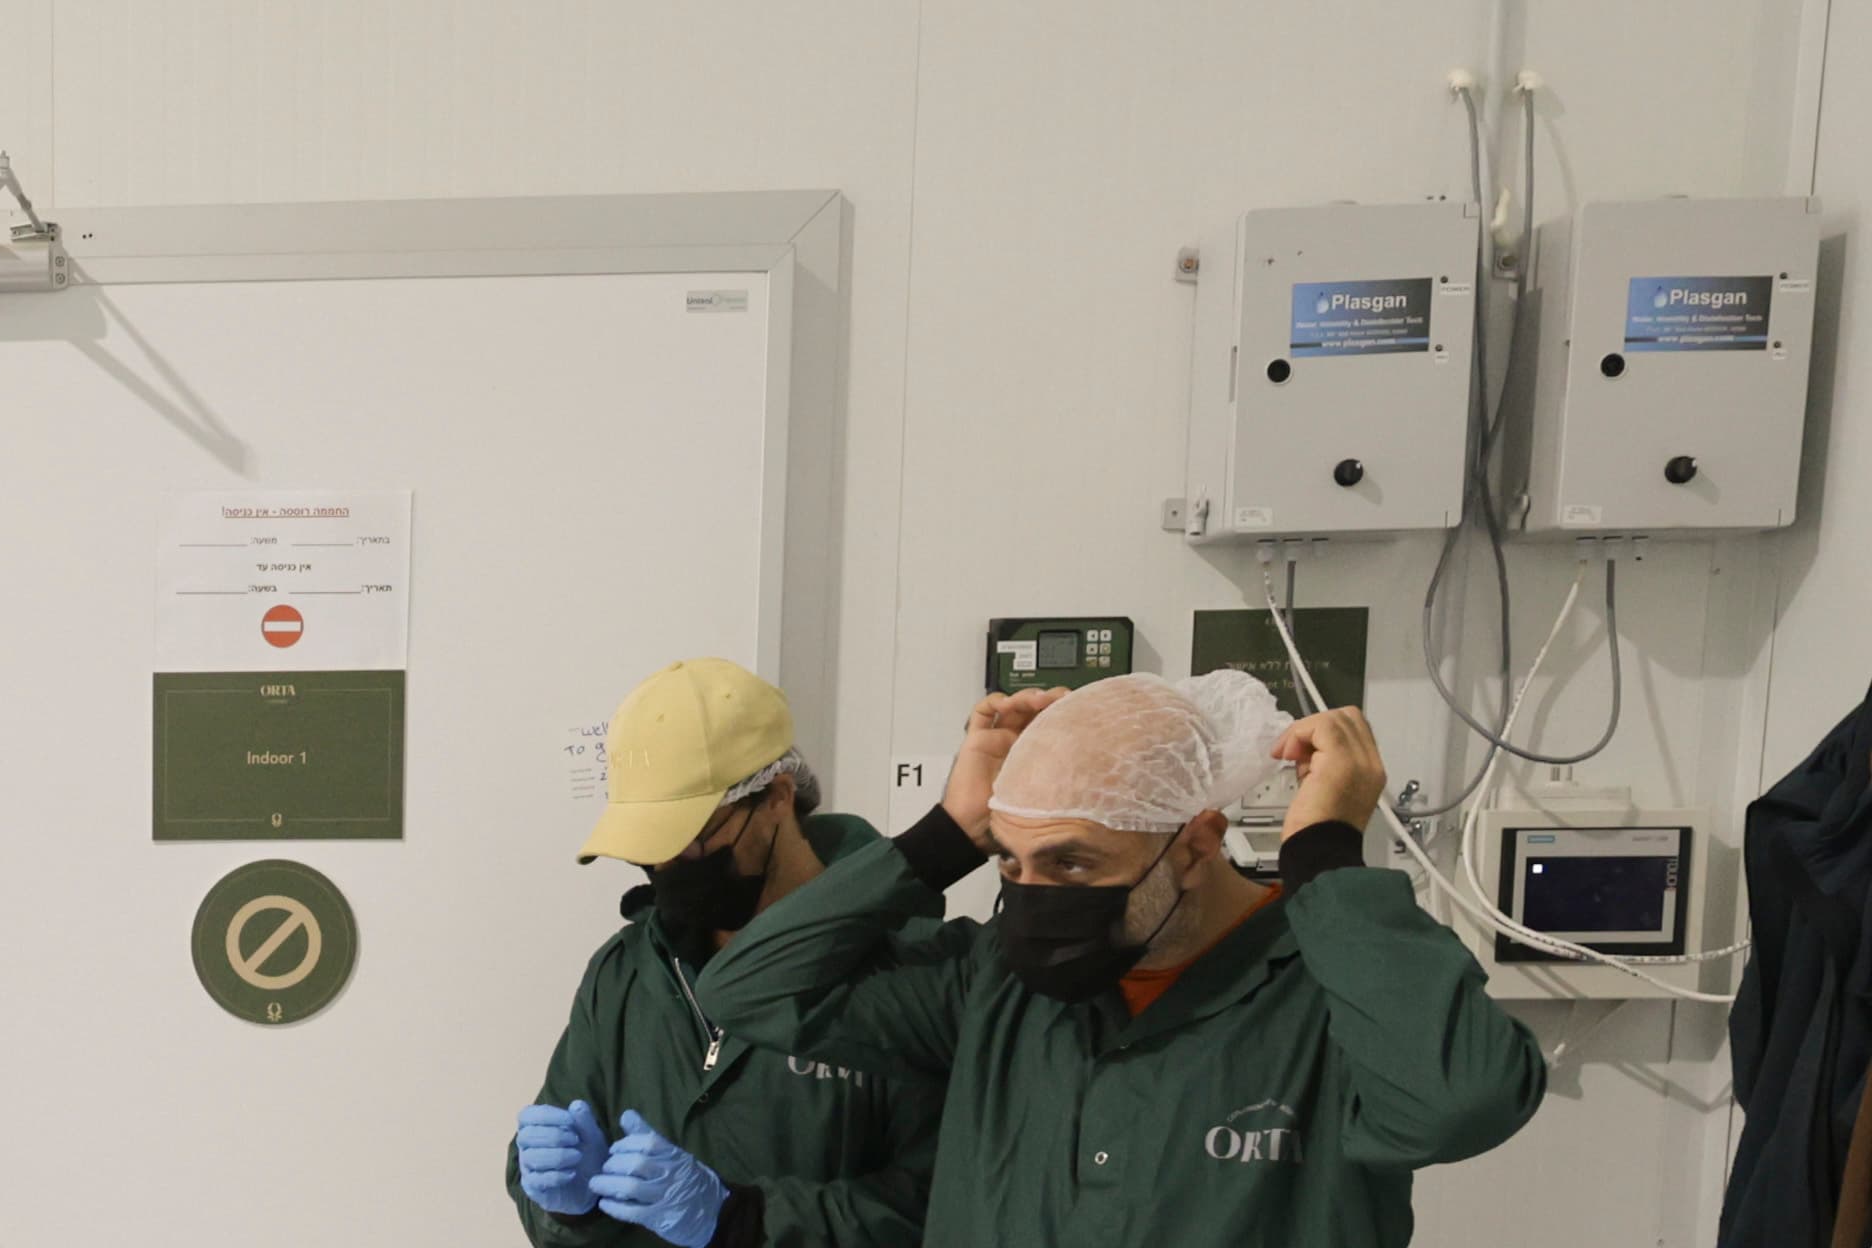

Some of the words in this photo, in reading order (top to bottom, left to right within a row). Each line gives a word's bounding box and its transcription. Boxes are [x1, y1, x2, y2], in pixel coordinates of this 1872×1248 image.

[1331, 293, 1408, 312] Plasgan
[1669, 289, 1748, 309] Plasgan
[260, 685, 296, 697] ORTA
[247, 751, 295, 765] Indoor
[299, 751, 307, 765] 1
[897, 763, 922, 787] F1
